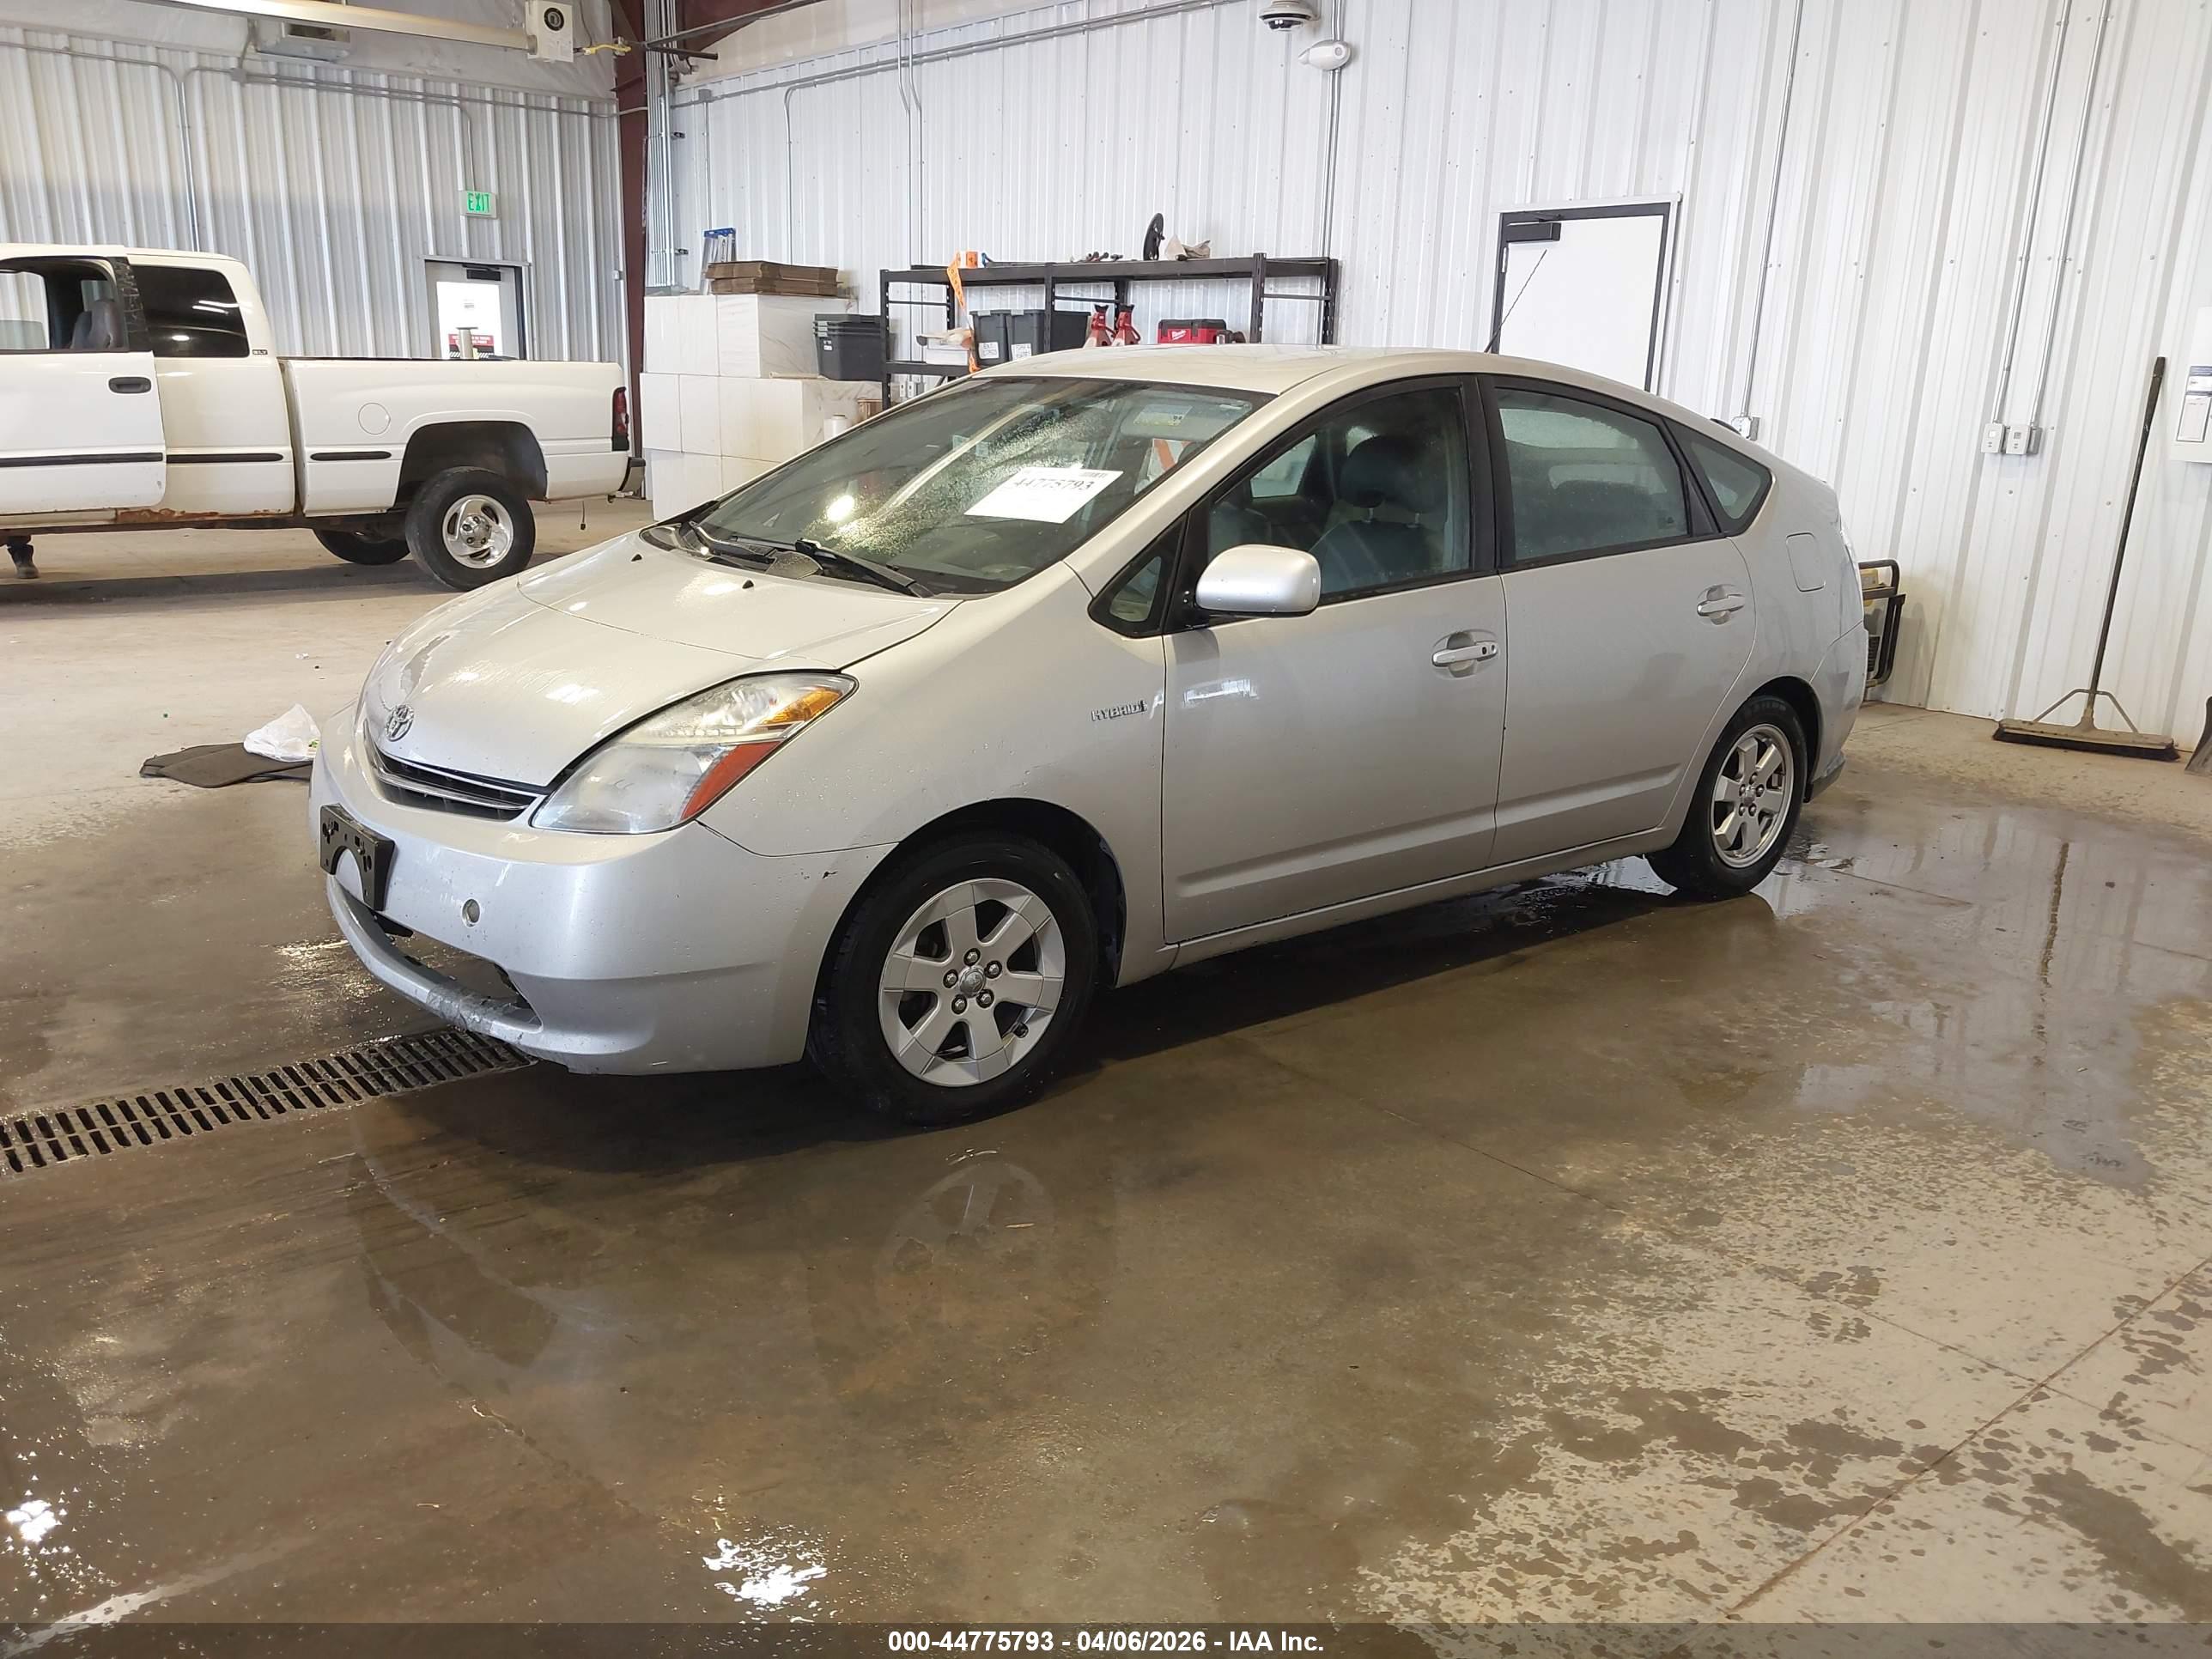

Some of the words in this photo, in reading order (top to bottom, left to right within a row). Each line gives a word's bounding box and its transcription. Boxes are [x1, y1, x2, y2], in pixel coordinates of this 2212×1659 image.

[467, 192, 490, 213] EXIT
[1013, 477, 1095, 490] 44775793
[1091, 700, 1147, 721] HYBRID
